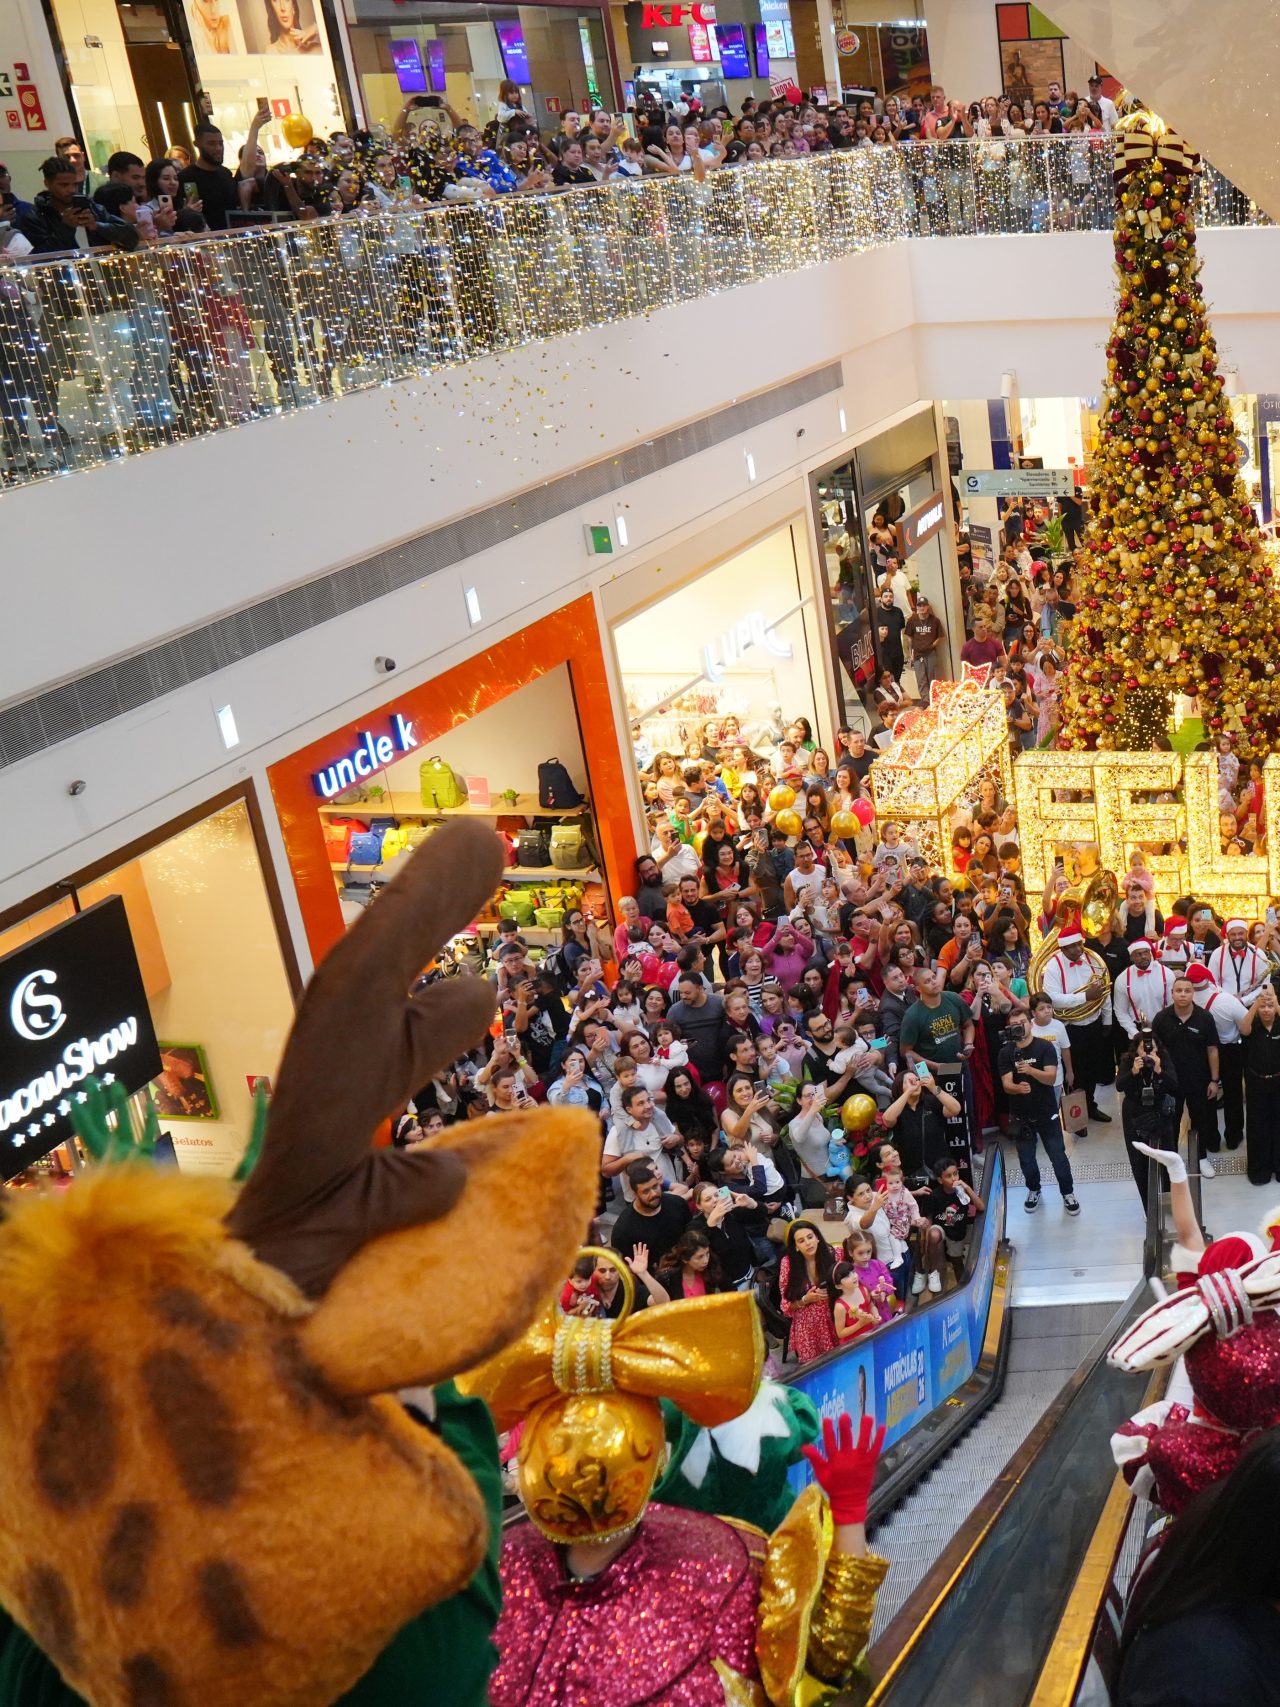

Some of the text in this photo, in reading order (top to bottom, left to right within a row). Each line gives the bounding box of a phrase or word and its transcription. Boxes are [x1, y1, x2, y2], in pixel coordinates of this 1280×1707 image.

[641, 3, 717, 29] KFC
[318, 713, 418, 797] uncle k
[931, 1016, 952, 1029] PAPAI
[0, 1016, 138, 1131] acauShow
[171, 1136, 214, 1148] Gelatos
[884, 1350, 917, 1393] MATRÍCULAS
